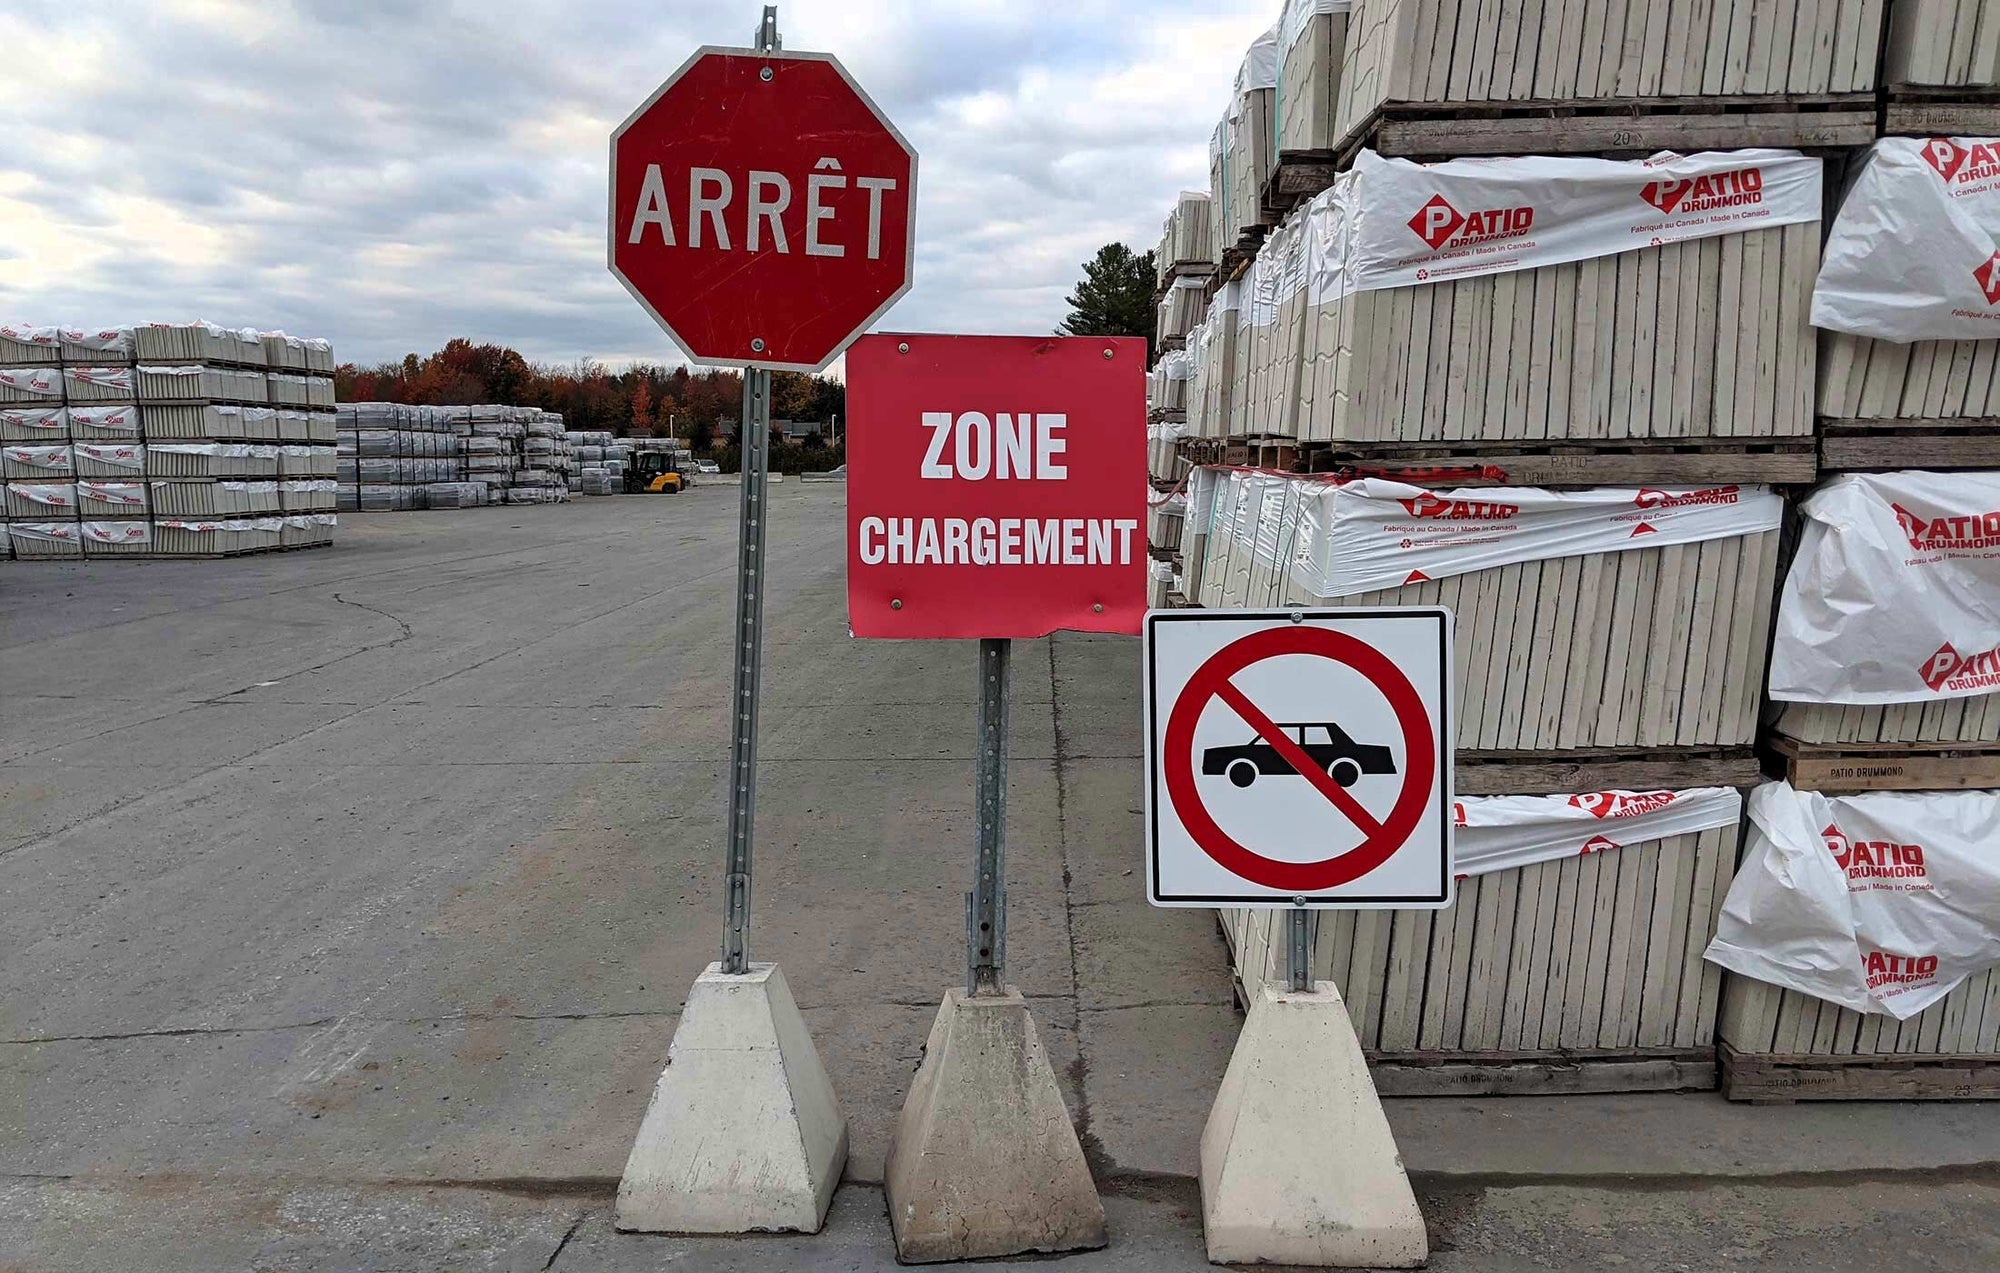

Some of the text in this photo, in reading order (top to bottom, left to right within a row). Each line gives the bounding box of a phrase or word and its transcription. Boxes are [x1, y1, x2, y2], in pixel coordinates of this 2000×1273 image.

[1613, 130, 1631, 146] 20
[1651, 166, 1763, 207] PATIO
[628, 157, 896, 260] ARRÊT
[1681, 191, 1763, 213] DRUMMOND
[1423, 203, 1536, 242] PATIO
[1665, 222, 1675, 230] au
[1675, 217, 1704, 228] Canada
[1710, 214, 1731, 223] Made
[1741, 208, 1770, 219] Canada
[1449, 228, 1529, 250] DRUMMOND
[1430, 253, 1441, 261] au
[1441, 249, 1470, 260] Canada
[1475, 247, 1497, 256] Made
[1506, 240, 1536, 251] Canada
[920, 410, 1068, 481] ZONE
[1427, 525, 1455, 533] Canada
[1490, 523, 1518, 532] Canada
[858, 515, 1138, 567] CHARGEMENT
[1830, 766, 1904, 779] PATIO DRUMMOND
[1823, 833, 1925, 867] PATIO
[1848, 865, 1927, 880] DRUMMOND
[1872, 883, 1894, 891] Made
[1904, 883, 1935, 891] Canada
[1865, 972, 1935, 990] DRUMMOND
